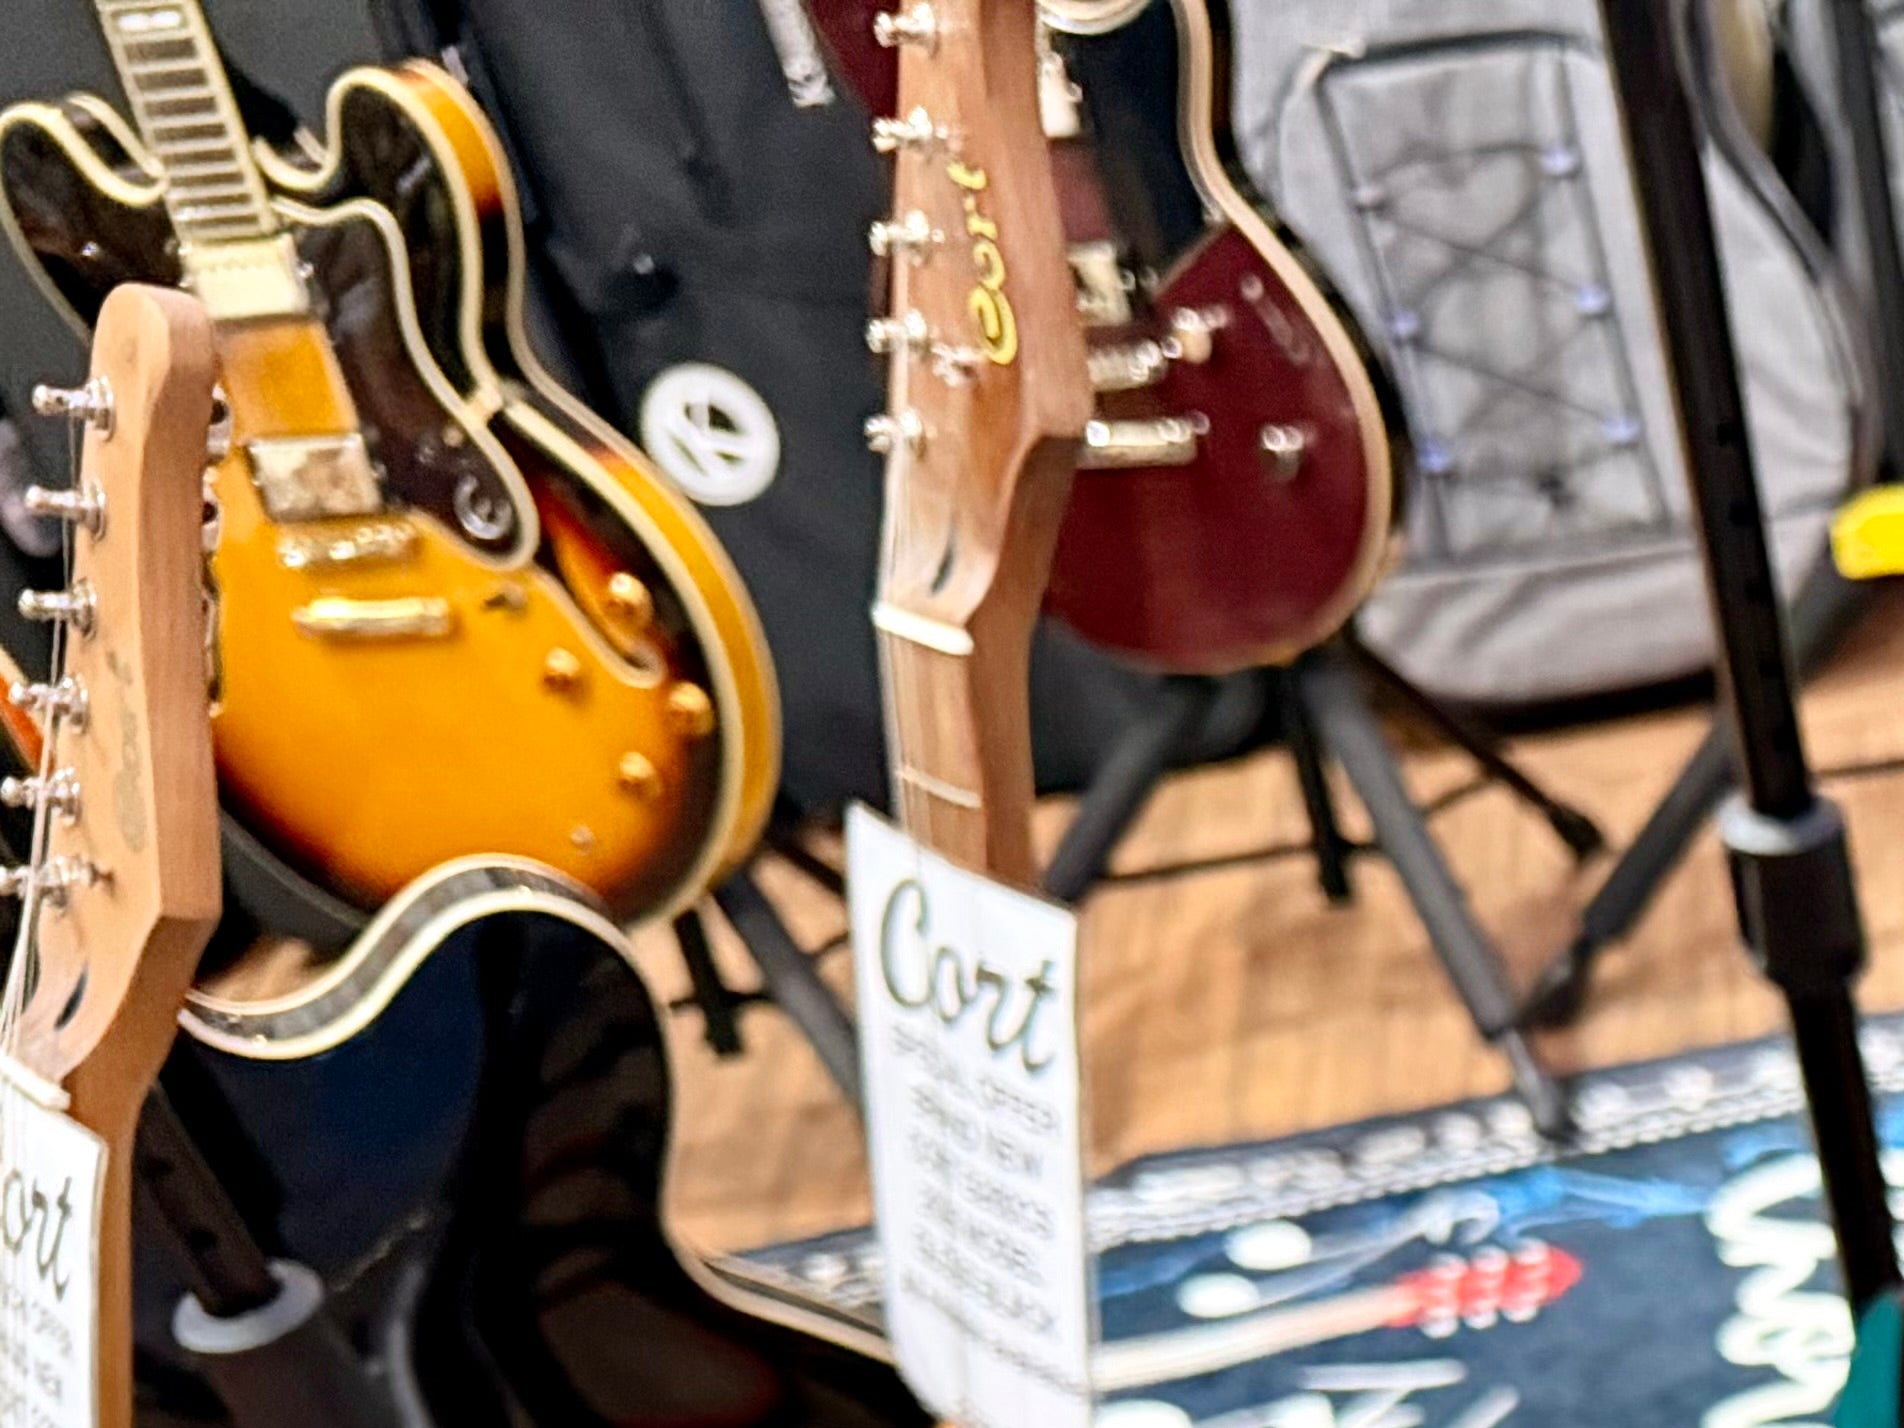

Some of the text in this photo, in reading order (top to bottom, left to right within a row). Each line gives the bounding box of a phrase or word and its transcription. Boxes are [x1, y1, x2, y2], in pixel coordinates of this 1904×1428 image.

[944, 160, 1018, 366] Cort
[880, 877, 1055, 1077] Cort
[2, 1169, 72, 1304] ort
